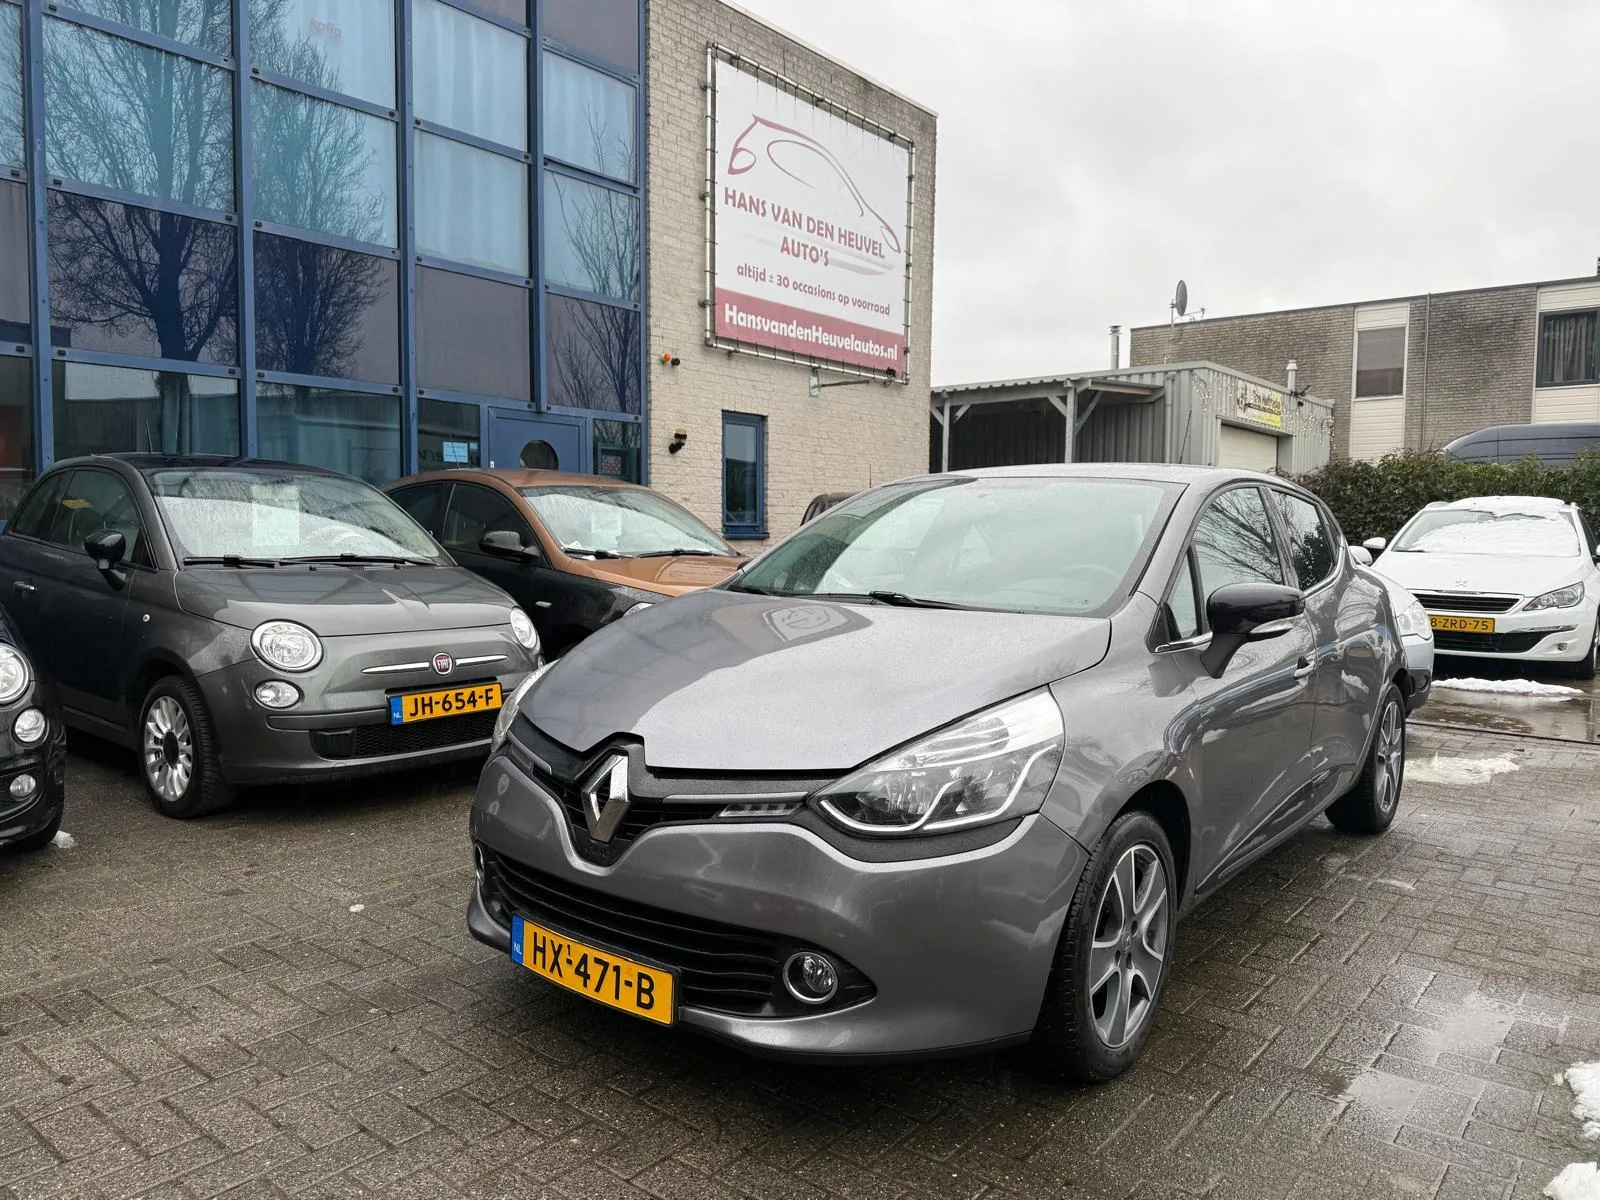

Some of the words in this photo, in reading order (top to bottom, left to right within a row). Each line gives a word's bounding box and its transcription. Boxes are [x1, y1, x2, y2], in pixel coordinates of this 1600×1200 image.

[724, 186, 767, 218] HANS
[771, 203, 802, 230] VAN
[806, 216, 834, 242] DEN
[838, 227, 885, 259] HEUVEL
[780, 236, 829, 266] AUTO'S
[736, 263, 766, 282] altijd
[776, 274, 789, 288] 30
[792, 280, 836, 301] occasions
[838, 293, 850, 307] op
[851, 297, 890, 316] voorraad
[724, 303, 898, 361] HansvandenHeuvelautos.nl
[1430, 617, 1489, 631] 8-ZRD-75
[409, 688, 494, 717] JH-654-F
[513, 942, 522, 955] NL
